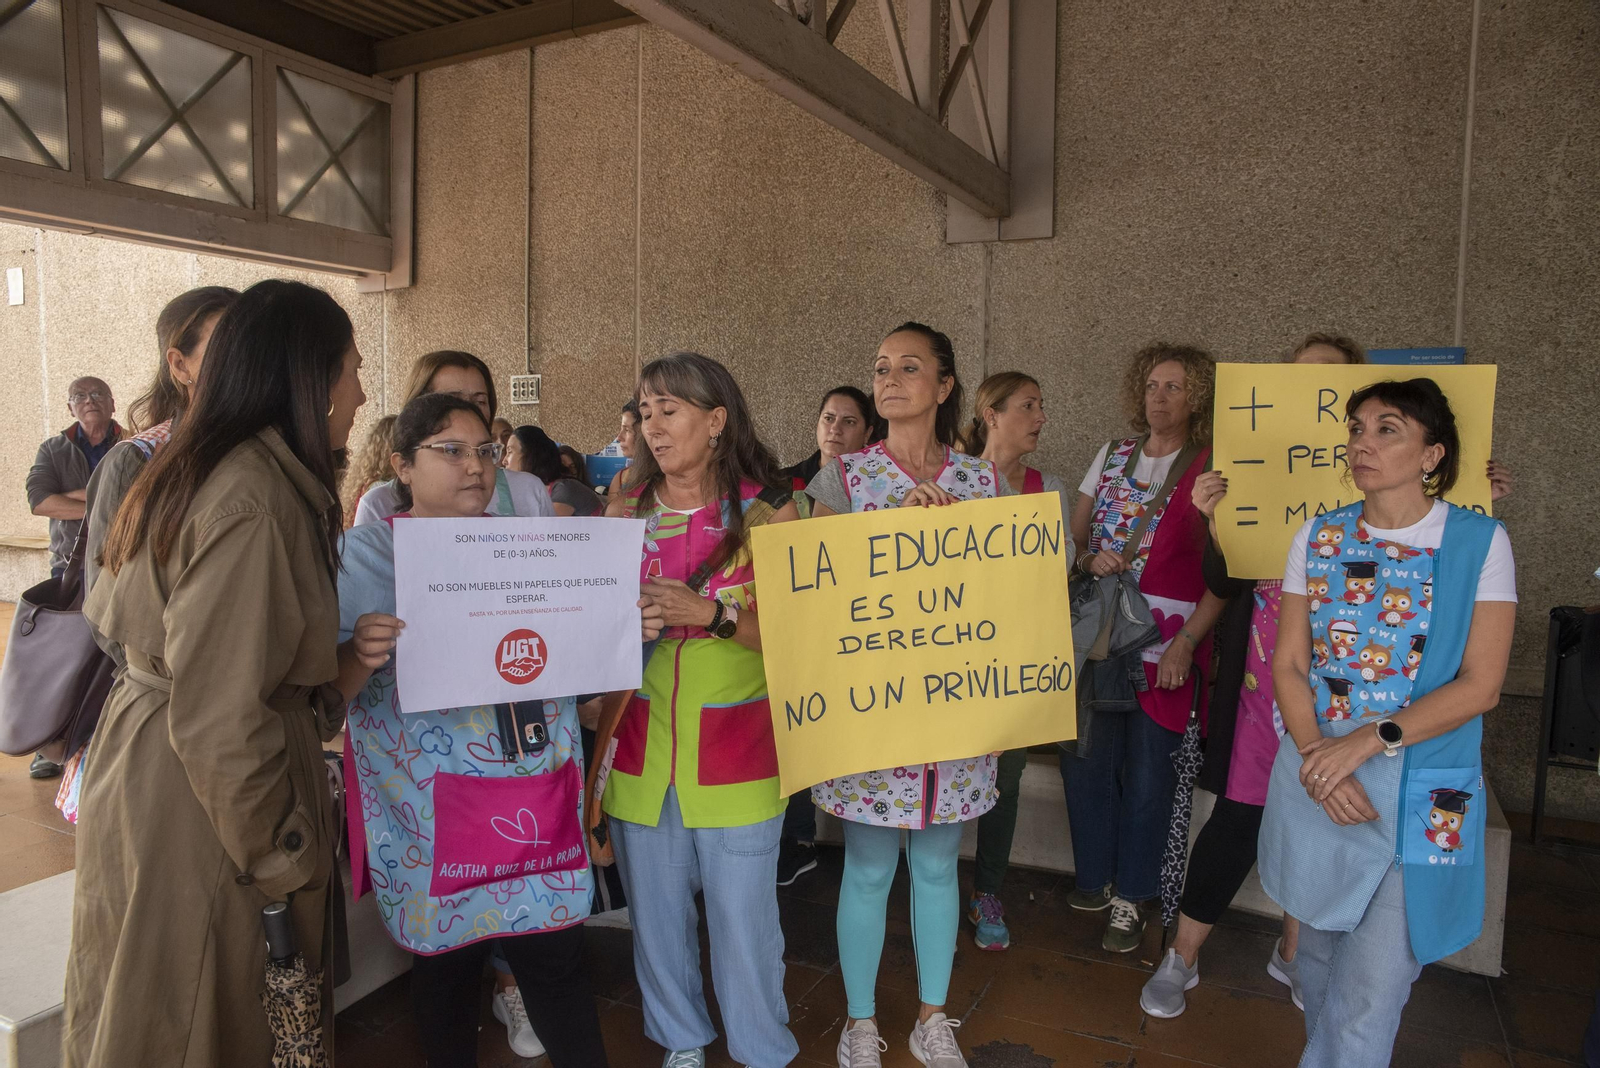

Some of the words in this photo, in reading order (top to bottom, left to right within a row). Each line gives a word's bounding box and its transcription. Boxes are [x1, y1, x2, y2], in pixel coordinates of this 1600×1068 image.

[455, 534, 476, 543] SON
[478, 532, 508, 543] NIÑOS
[510, 534, 515, 542] Y
[518, 532, 545, 542] NIÑAS
[547, 533, 590, 542] MENORES
[493, 550, 506, 559] DE
[508, 549, 527, 559] (0-3)
[529, 547, 557, 558] AÑOS,
[1346, 548, 1374, 558] OWL
[789, 542, 837, 592] LA
[1306, 560, 1337, 572] OWL
[1382, 567, 1422, 579] OWL
[428, 584, 444, 592] NO
[446, 583, 466, 592] SON
[469, 581, 511, 591] MUEBLES
[514, 581, 523, 589] NI
[525, 579, 562, 589] PAPELES
[564, 579, 582, 589] QUE
[584, 577, 617, 587] PUEDEN
[506, 594, 548, 604] ESPERAR.
[850, 594, 895, 622] ES
[918, 583, 964, 613] UN
[1338, 608, 1363, 616] OWL
[837, 620, 996, 654] DERECHO
[1369, 626, 1398, 642] OWL
[502, 637, 541, 662] UGT
[1359, 690, 1399, 701] OWL
[786, 692, 826, 731] NO
[850, 676, 904, 712] UN
[439, 862, 487, 878] AGATHA
[494, 862, 519, 877] RUIZ
[524, 859, 537, 871] DE
[541, 857, 552, 870] LA
[556, 844, 582, 864] PRADA
[1428, 854, 1456, 864] OWL
